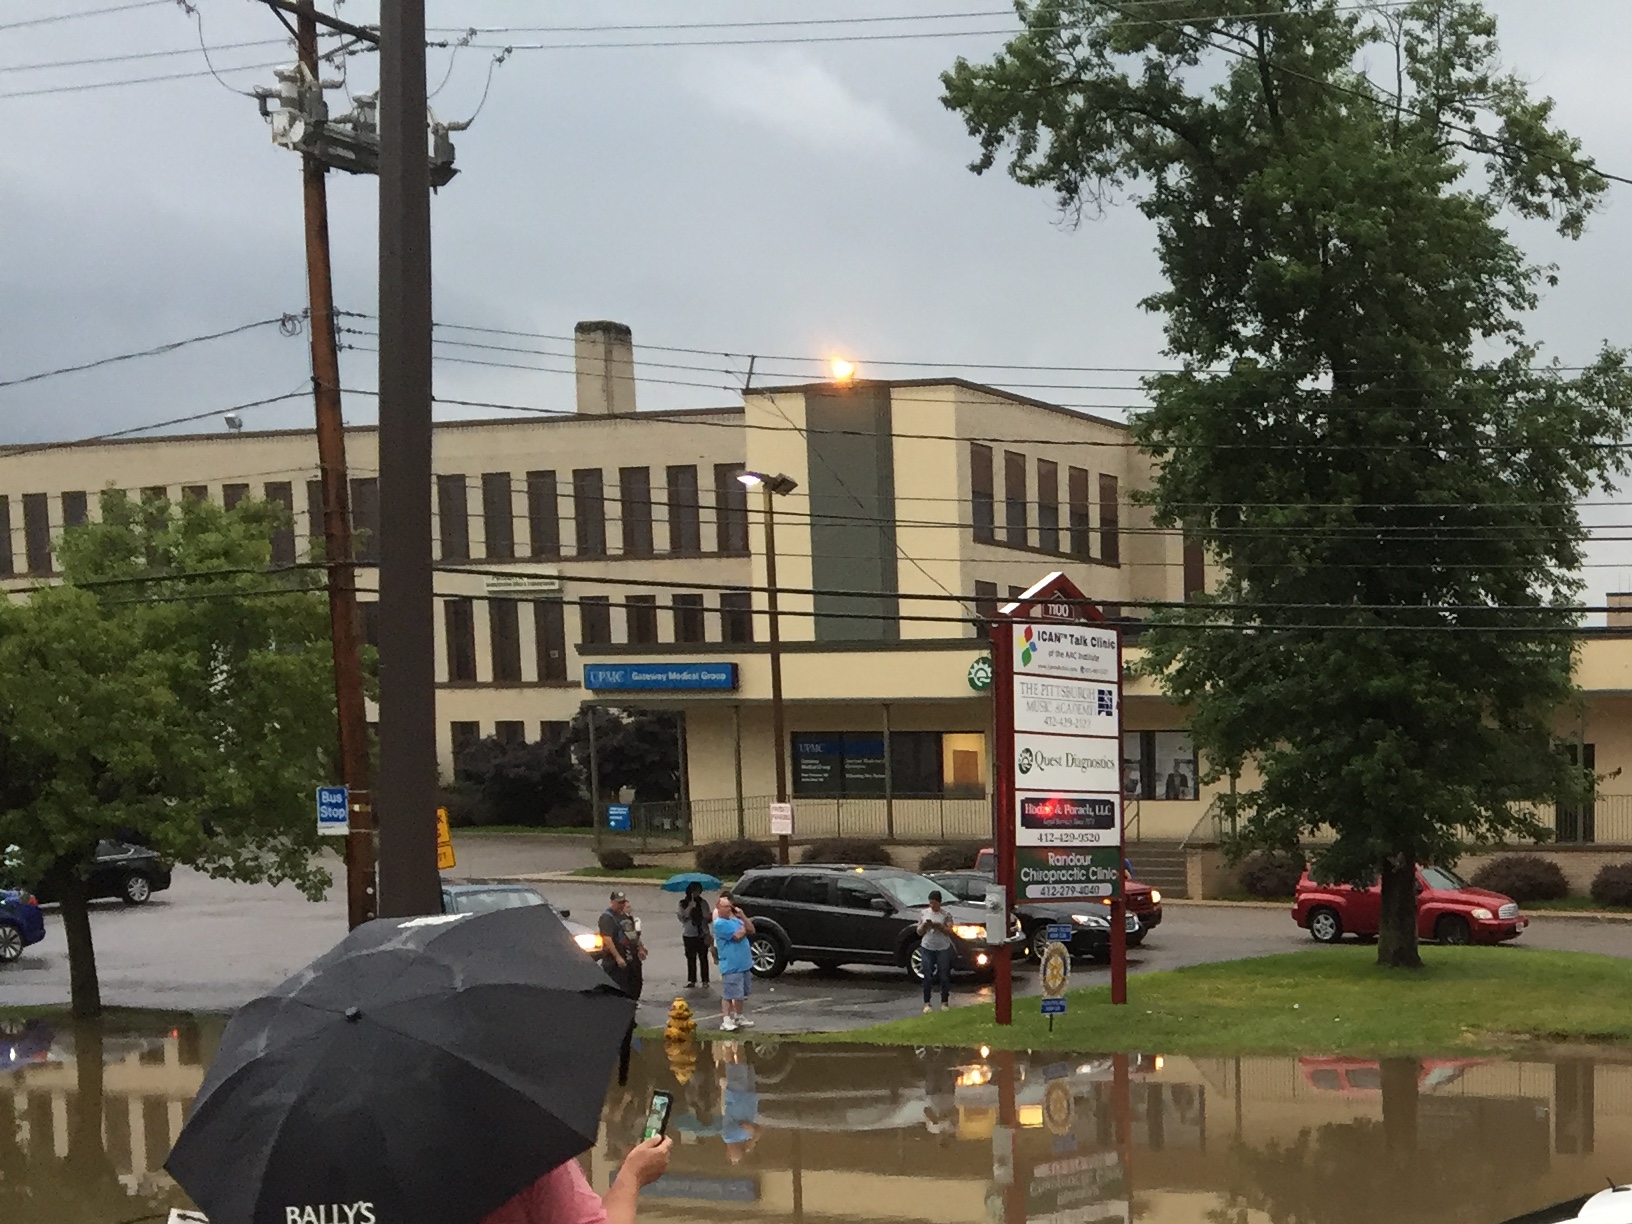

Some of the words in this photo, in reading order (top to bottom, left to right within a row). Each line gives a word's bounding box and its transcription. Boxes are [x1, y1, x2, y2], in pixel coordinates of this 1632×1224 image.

[1047, 603, 1069, 617] 1100
[1069, 634, 1088, 647] Talk
[1090, 636, 1116, 650] Clinic
[631, 672, 667, 682] Gateway
[668, 670, 699, 681] Medical
[701, 671, 726, 682] Group
[1020, 682, 1038, 696] THE
[1041, 684, 1096, 700] PITTSBURGH
[1026, 700, 1052, 713] MUSIC
[1035, 750, 1062, 771] Quest
[1065, 752, 1115, 773] Diagnostics
[321, 791, 343, 804] Bus
[320, 805, 346, 819] Stop
[1055, 804, 1063, 815] &
[1095, 804, 1112, 816] LLC
[1048, 851, 1092, 867] Randour
[1021, 867, 1086, 883] Chiropractic
[1089, 866, 1118, 881] Clinic
[1040, 885, 1100, 897] 412-279-4040
